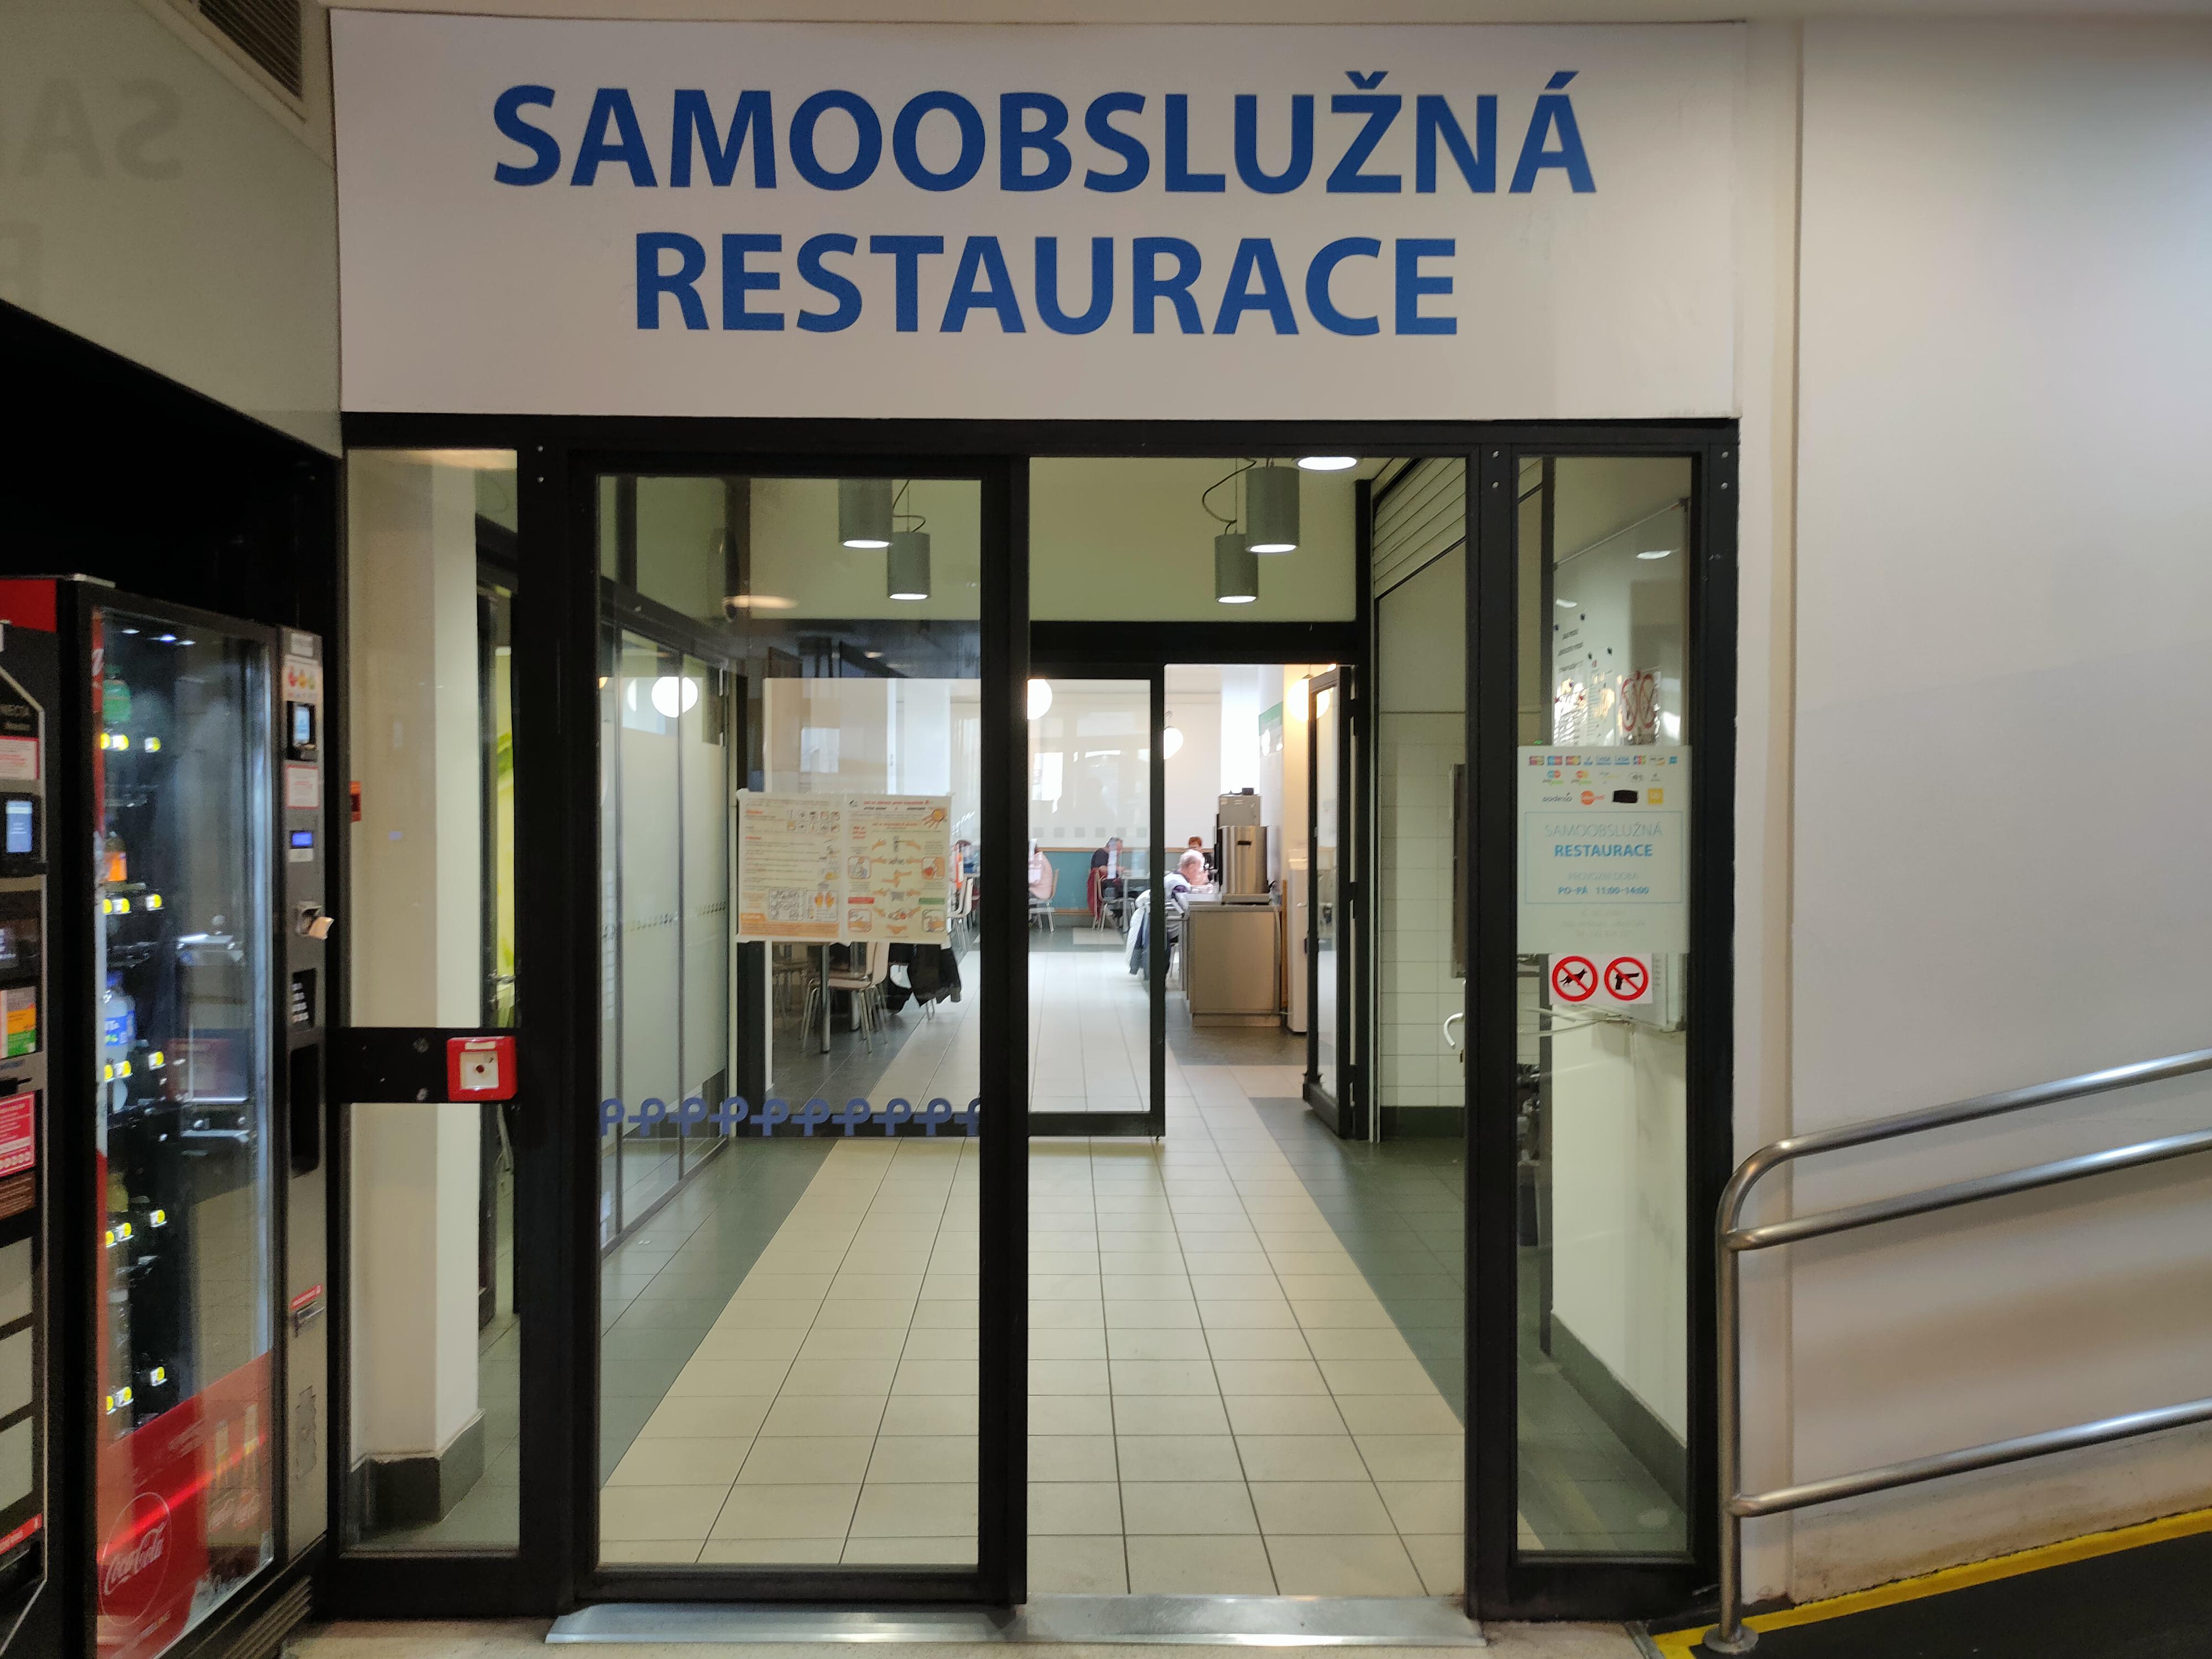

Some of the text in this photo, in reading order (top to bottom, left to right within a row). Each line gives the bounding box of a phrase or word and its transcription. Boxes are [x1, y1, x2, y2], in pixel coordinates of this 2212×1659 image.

[494, 72, 1594, 194] SAMOOBSLUŽNÁ
[637, 232, 1457, 336] RESTAURACE
[1544, 821, 1663, 837] SAMOOBSLUŽNÁ
[1554, 844, 1653, 857] RESTAURACE
[1557, 885, 1588, 894] PO-PÁ
